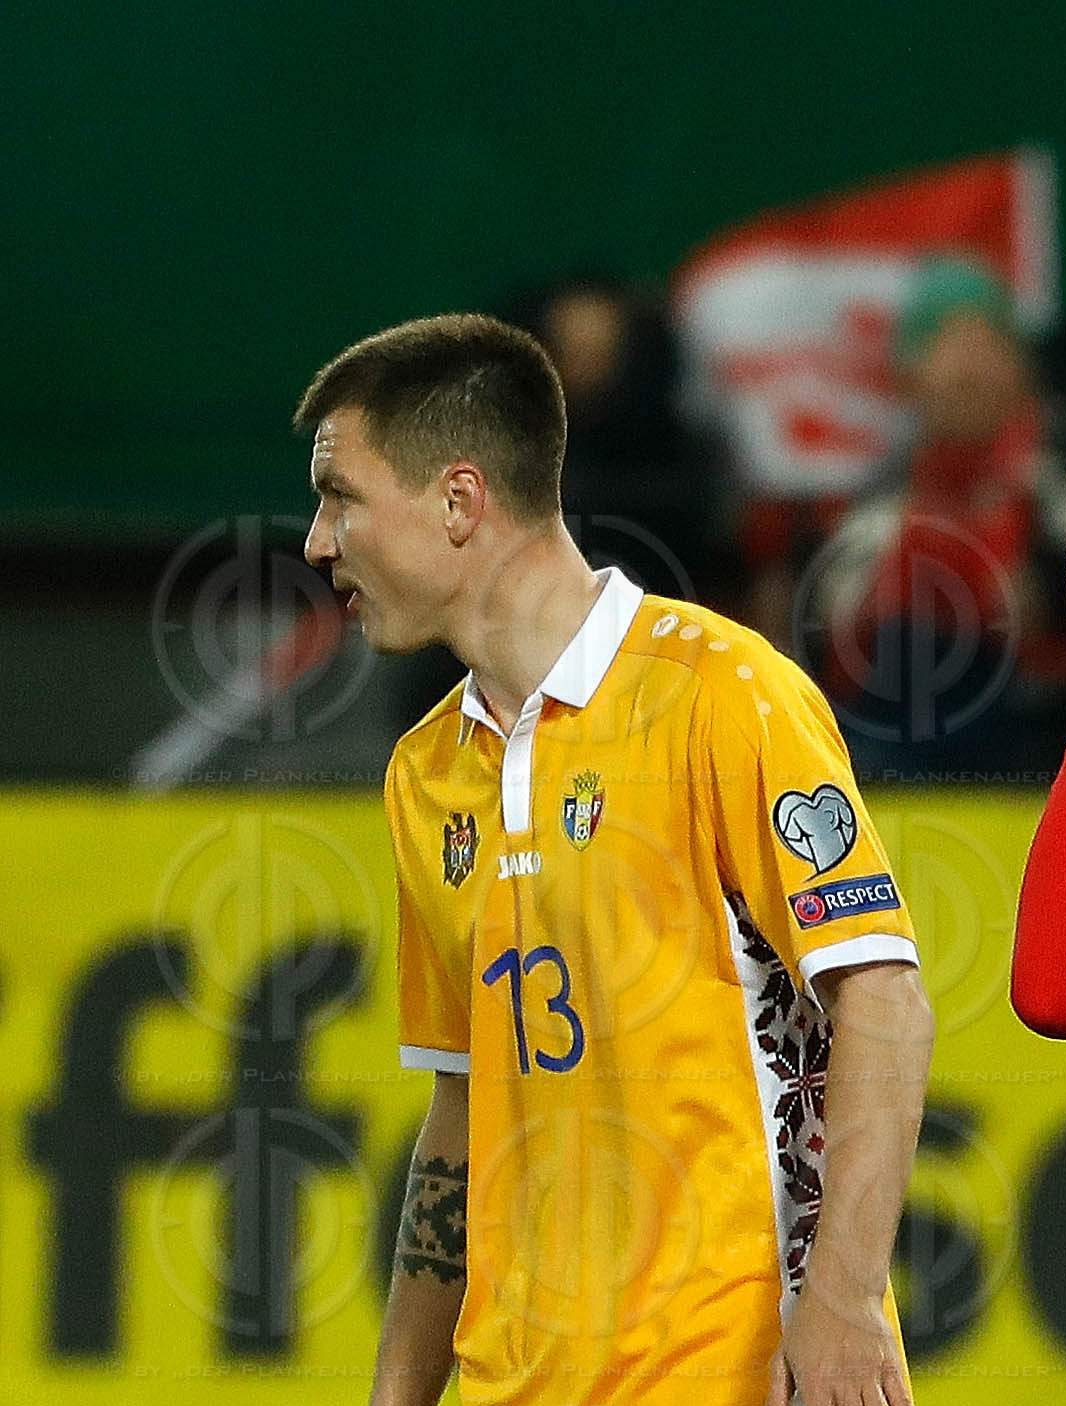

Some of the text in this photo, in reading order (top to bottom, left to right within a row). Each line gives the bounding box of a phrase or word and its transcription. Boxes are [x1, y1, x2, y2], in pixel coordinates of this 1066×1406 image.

[498, 850, 542, 881] JAKO
[824, 883, 893, 911] RESPECT
[481, 945, 585, 1075] 13
